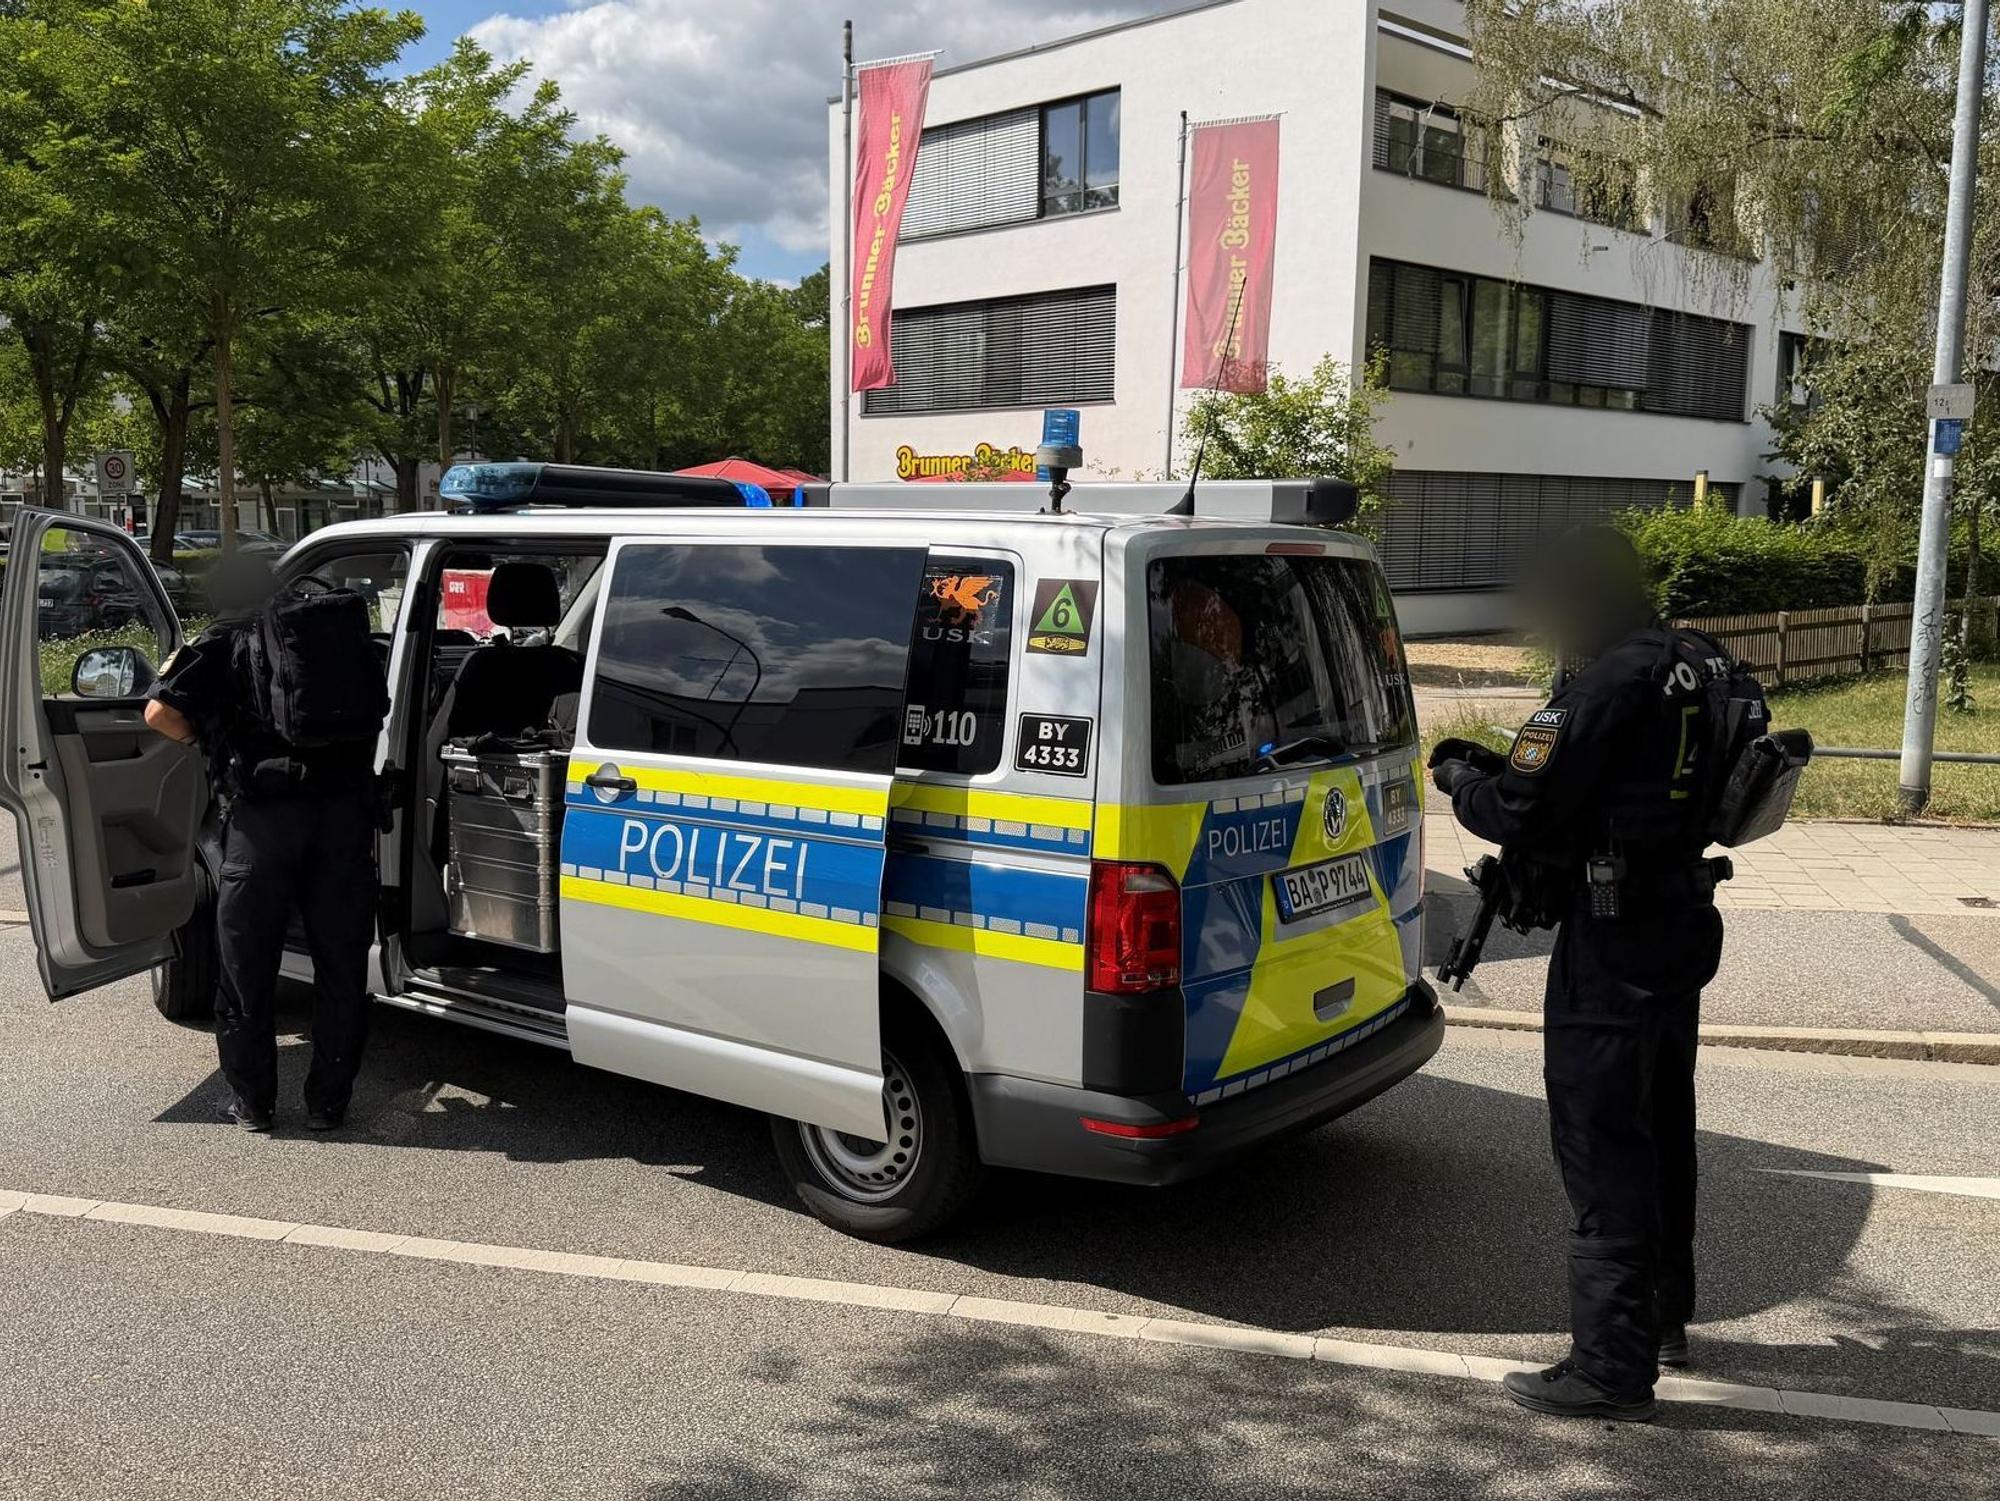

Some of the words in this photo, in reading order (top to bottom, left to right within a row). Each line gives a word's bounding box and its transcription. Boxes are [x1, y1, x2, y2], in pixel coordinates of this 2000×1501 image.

[1219, 157, 1250, 250] Bäcker
[856, 223, 885, 348] Brunner
[1213, 254, 1248, 358] Brunner
[109, 462, 121, 474] 30
[896, 444, 972, 481] Brunner
[1052, 598, 1072, 629] 6
[922, 626, 994, 645] USK
[1385, 672, 1407, 687] USK
[932, 710, 977, 746] 110
[1038, 721, 1070, 741] BY
[1534, 711, 1562, 724] USK
[1523, 731, 1554, 742] POLIZEI
[1024, 745, 1080, 768] 4333
[1208, 817, 1288, 860] POLIZEI
[619, 819, 809, 899] POLIZEI
[1287, 875, 1314, 909] BA
